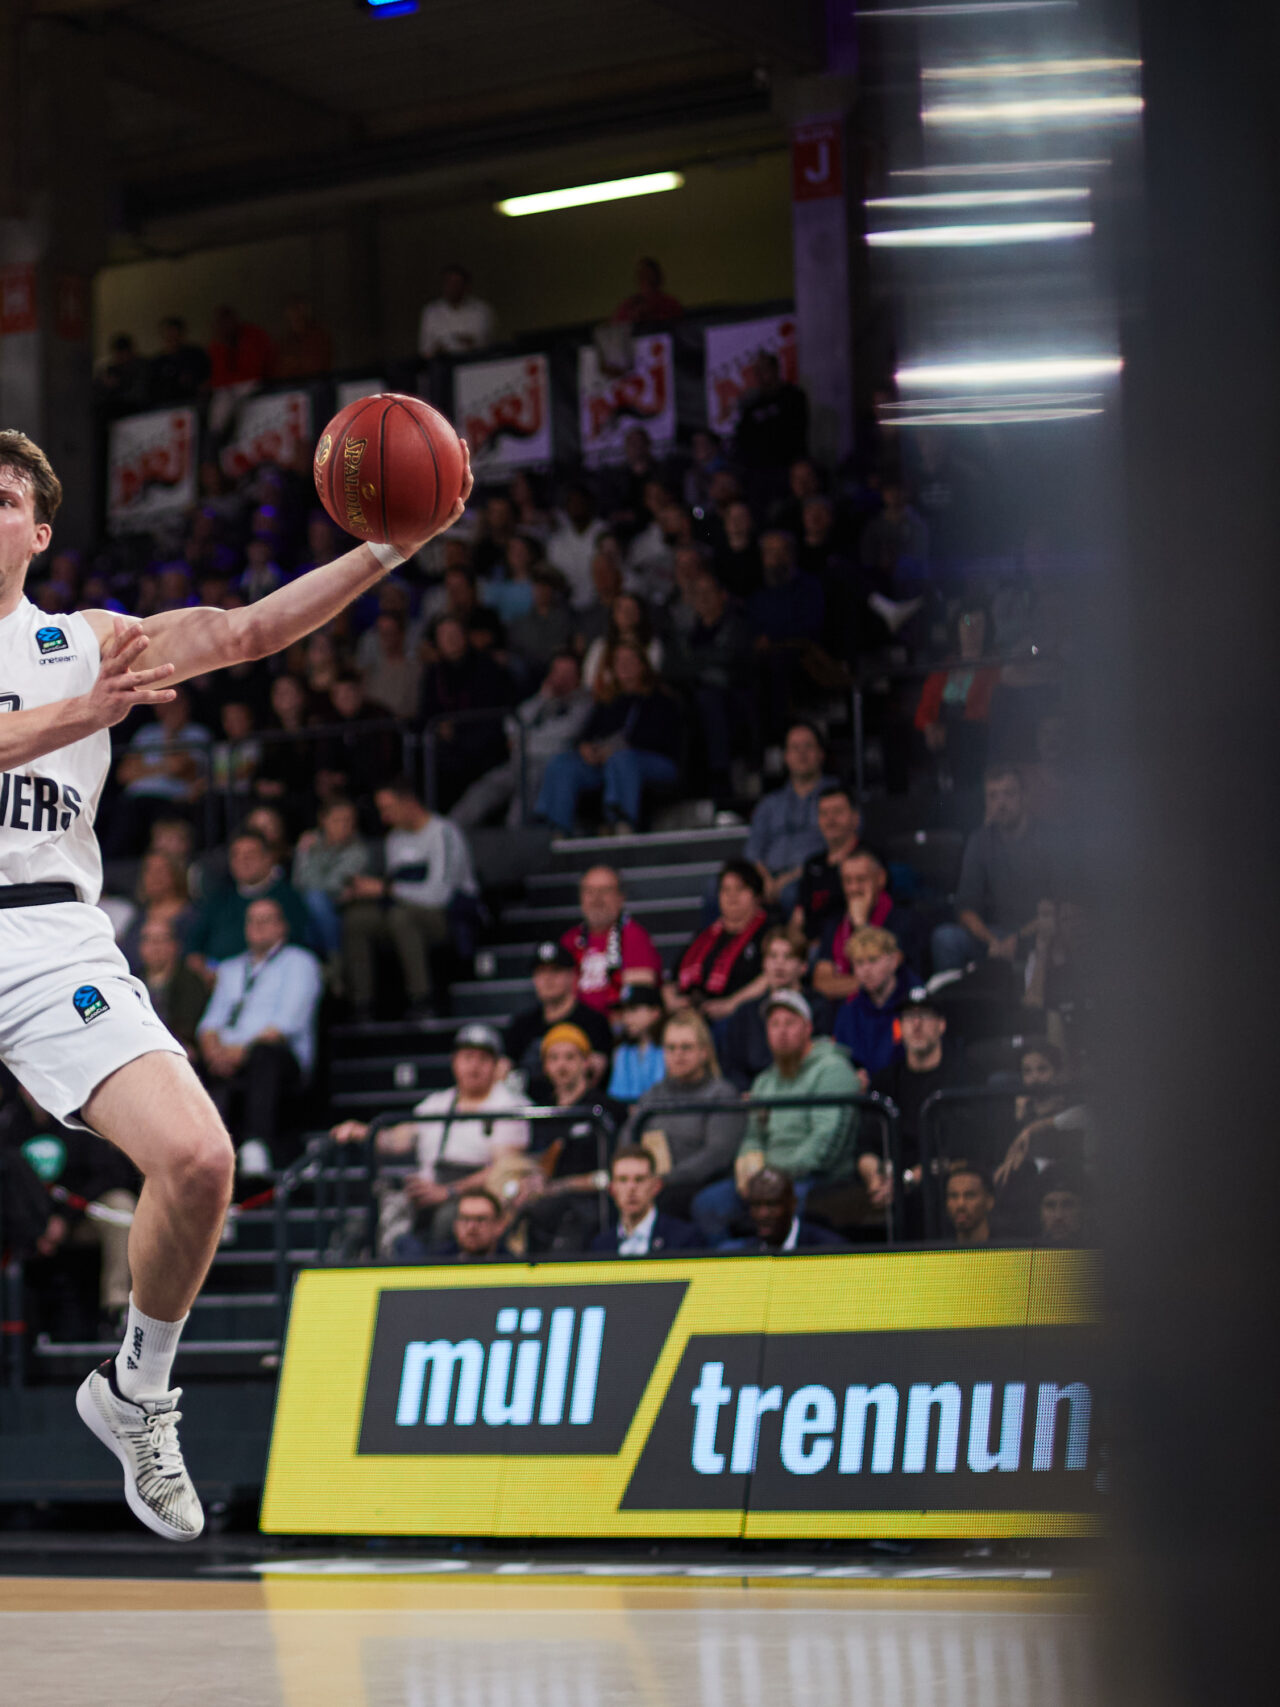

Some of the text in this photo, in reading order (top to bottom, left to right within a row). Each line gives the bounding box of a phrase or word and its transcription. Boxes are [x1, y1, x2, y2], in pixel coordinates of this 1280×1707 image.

[804, 141, 830, 183] J
[394, 1305, 607, 1428] müll
[690, 1361, 1094, 1476] trennun
